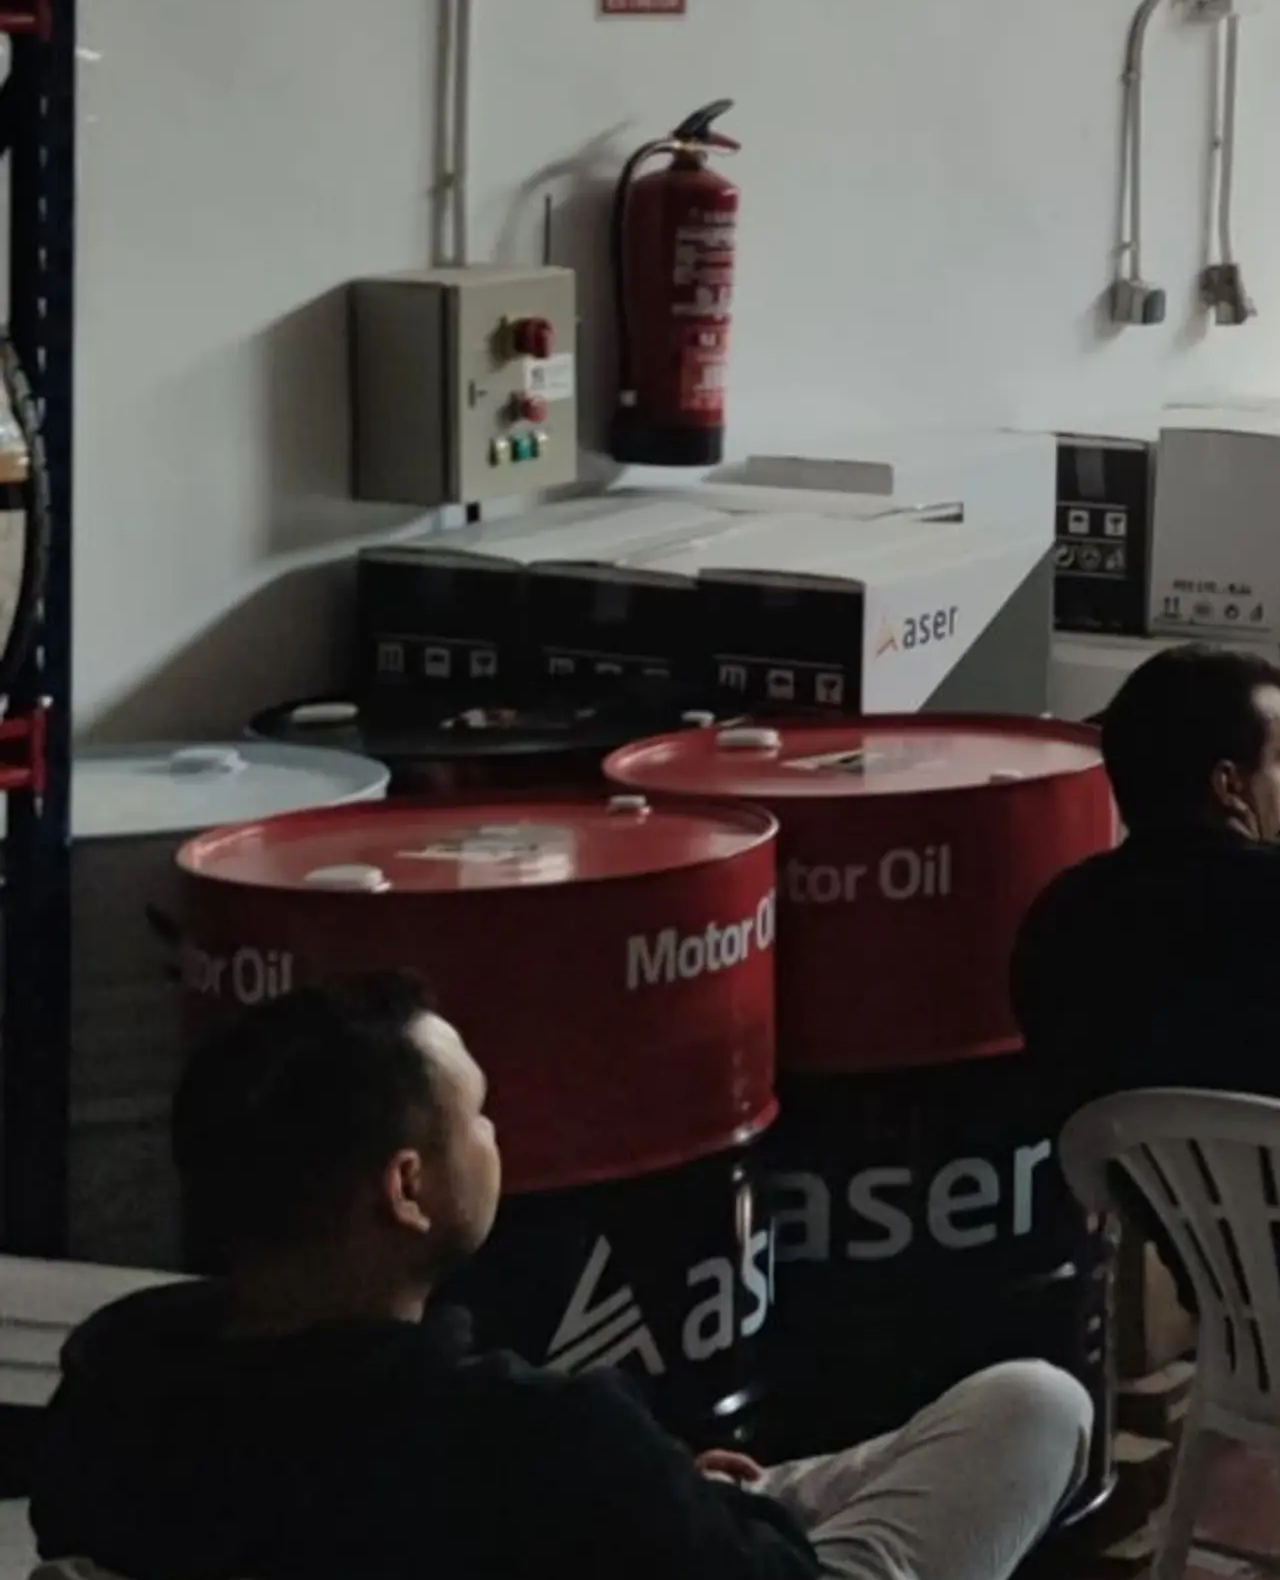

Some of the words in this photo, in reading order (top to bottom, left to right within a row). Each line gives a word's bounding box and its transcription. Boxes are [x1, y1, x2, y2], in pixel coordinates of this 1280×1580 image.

[902, 605, 959, 651] aser
[784, 854, 868, 904] tor
[877, 844, 952, 901] Oil
[626, 916, 755, 991] Motor
[768, 1138, 1052, 1264] aser
